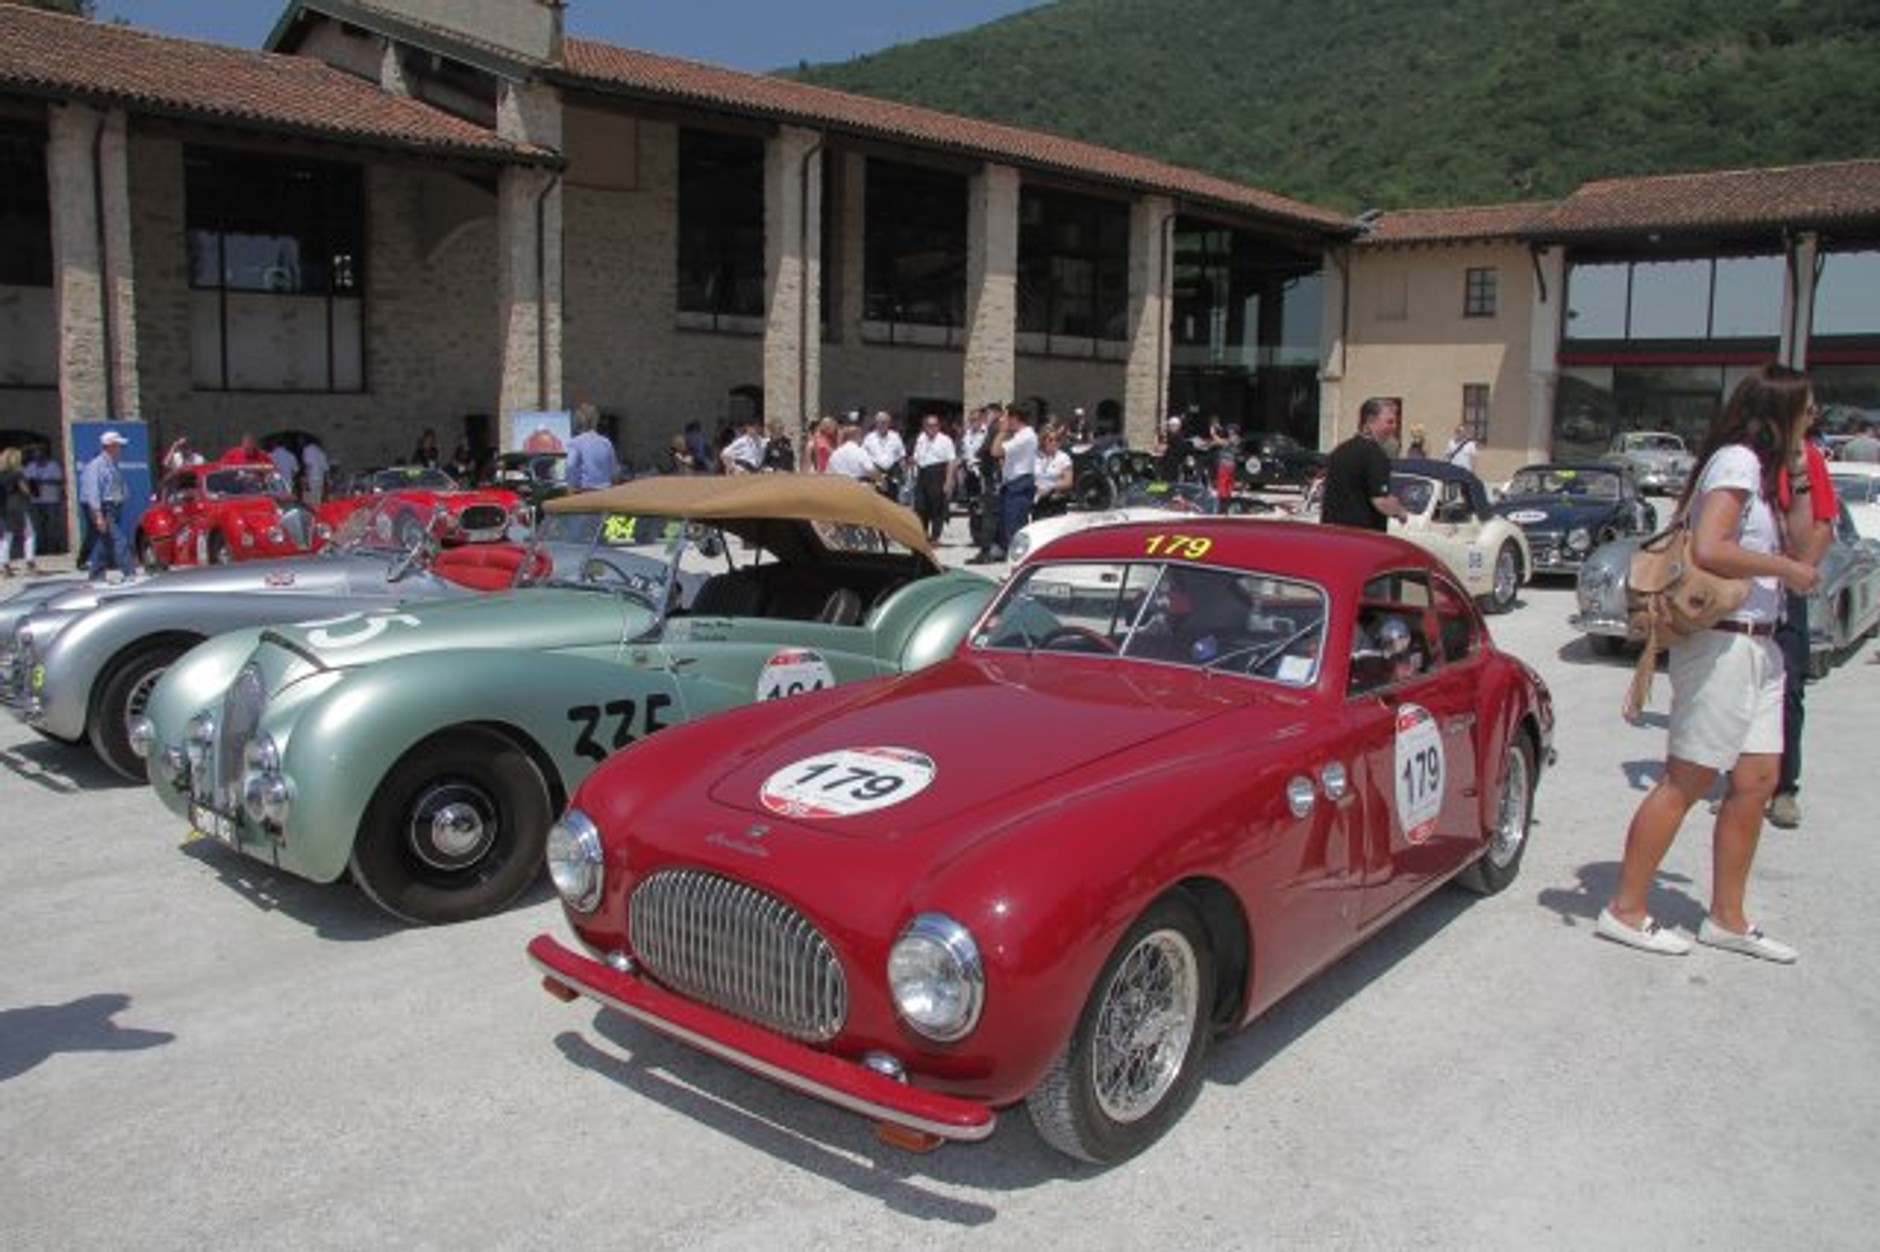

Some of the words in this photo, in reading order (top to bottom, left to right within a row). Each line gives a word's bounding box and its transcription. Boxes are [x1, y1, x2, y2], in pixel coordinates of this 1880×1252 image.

[1145, 534, 1212, 559] 179
[293, 607, 421, 648] 5
[796, 762, 904, 800] 179
[1402, 745, 1439, 805] 179
